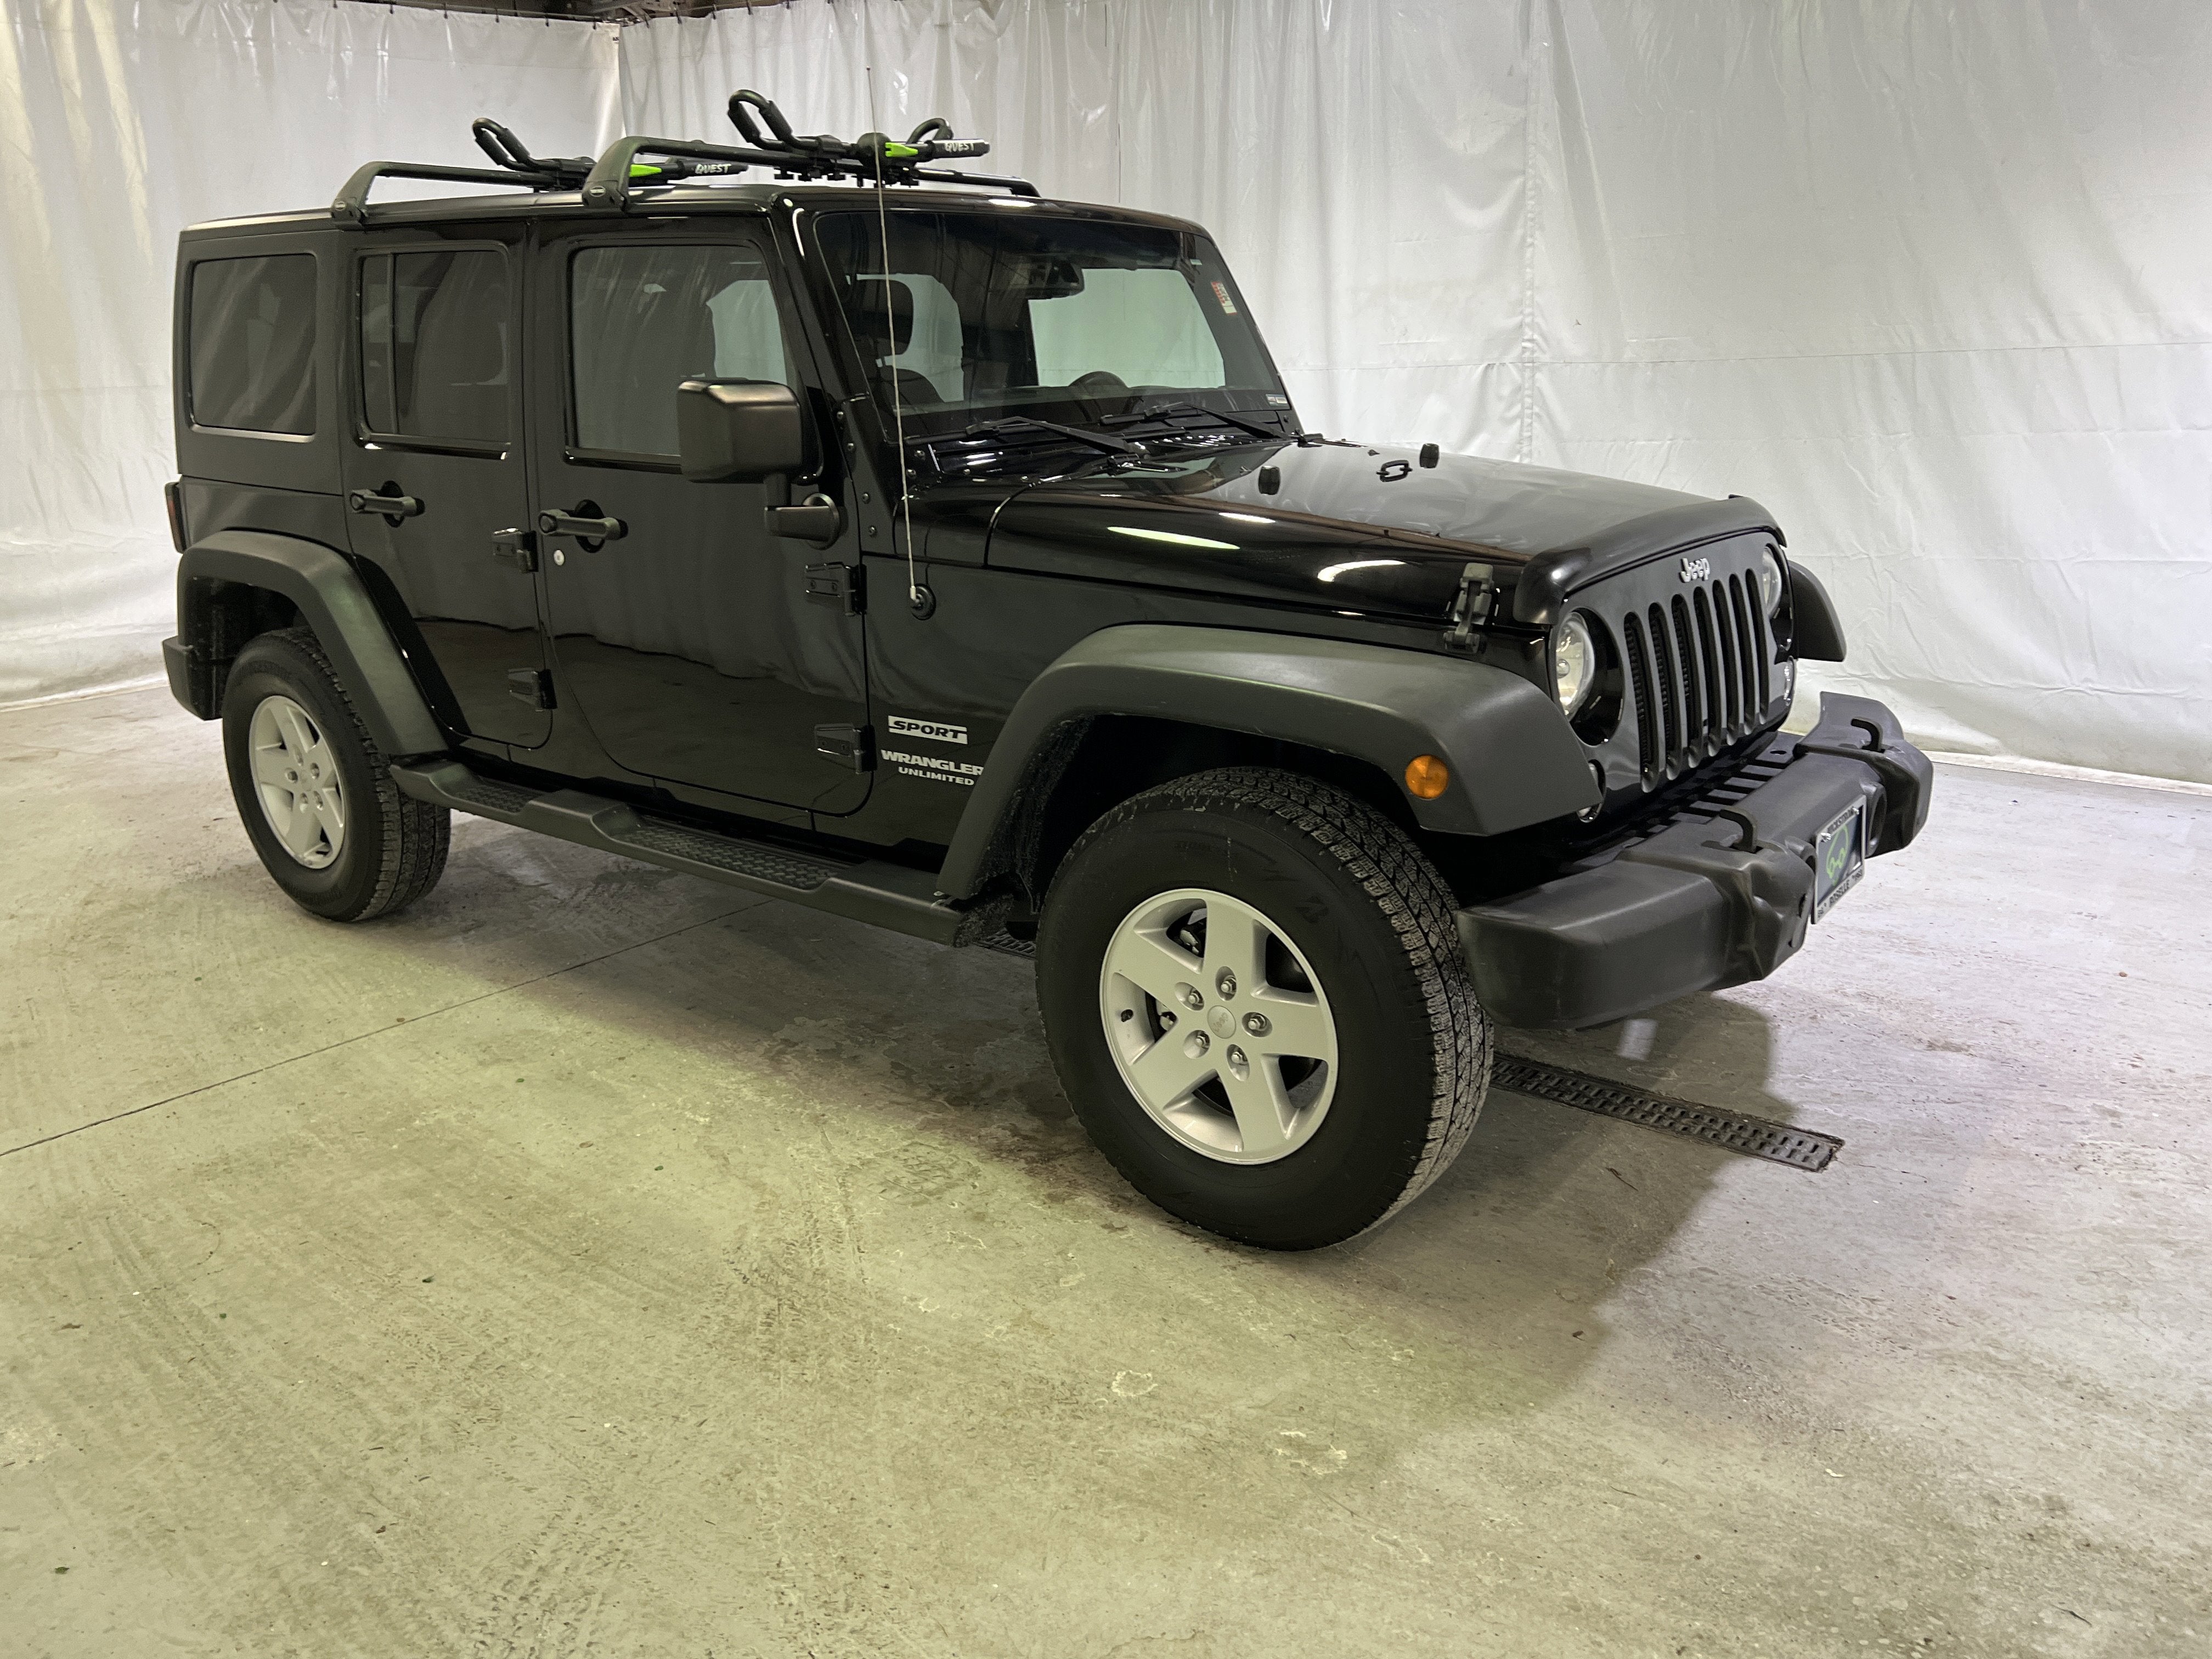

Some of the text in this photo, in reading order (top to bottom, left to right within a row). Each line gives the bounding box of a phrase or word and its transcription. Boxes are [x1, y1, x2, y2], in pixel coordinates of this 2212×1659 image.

[944, 142, 974, 153] QUEST
[695, 163, 732, 174] QUEST
[1680, 557, 1711, 583] Jeep
[889, 719, 967, 740] SPORT
[881, 749, 984, 776] WRANGLER
[898, 766, 975, 786] UNLIMITED
